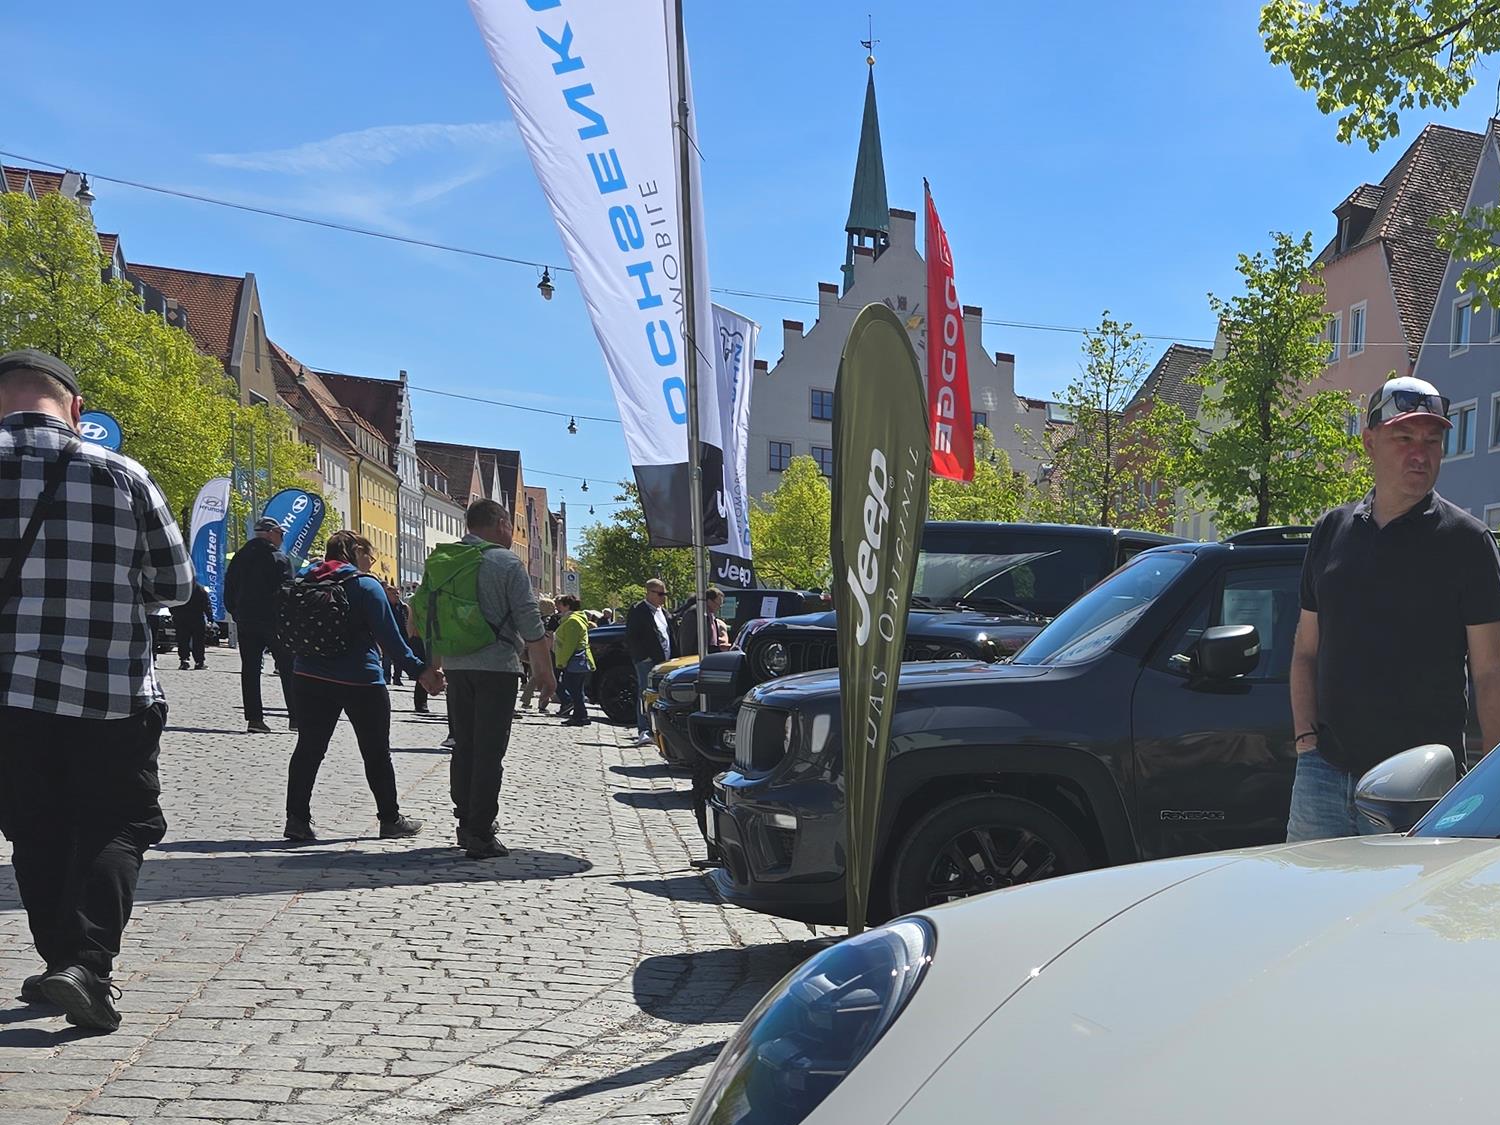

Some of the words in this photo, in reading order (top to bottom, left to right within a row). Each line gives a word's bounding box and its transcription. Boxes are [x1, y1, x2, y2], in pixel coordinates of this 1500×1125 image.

[206, 529, 217, 575] Platzer
[846, 448, 887, 646] Jeep
[717, 558, 751, 588] Jeep
